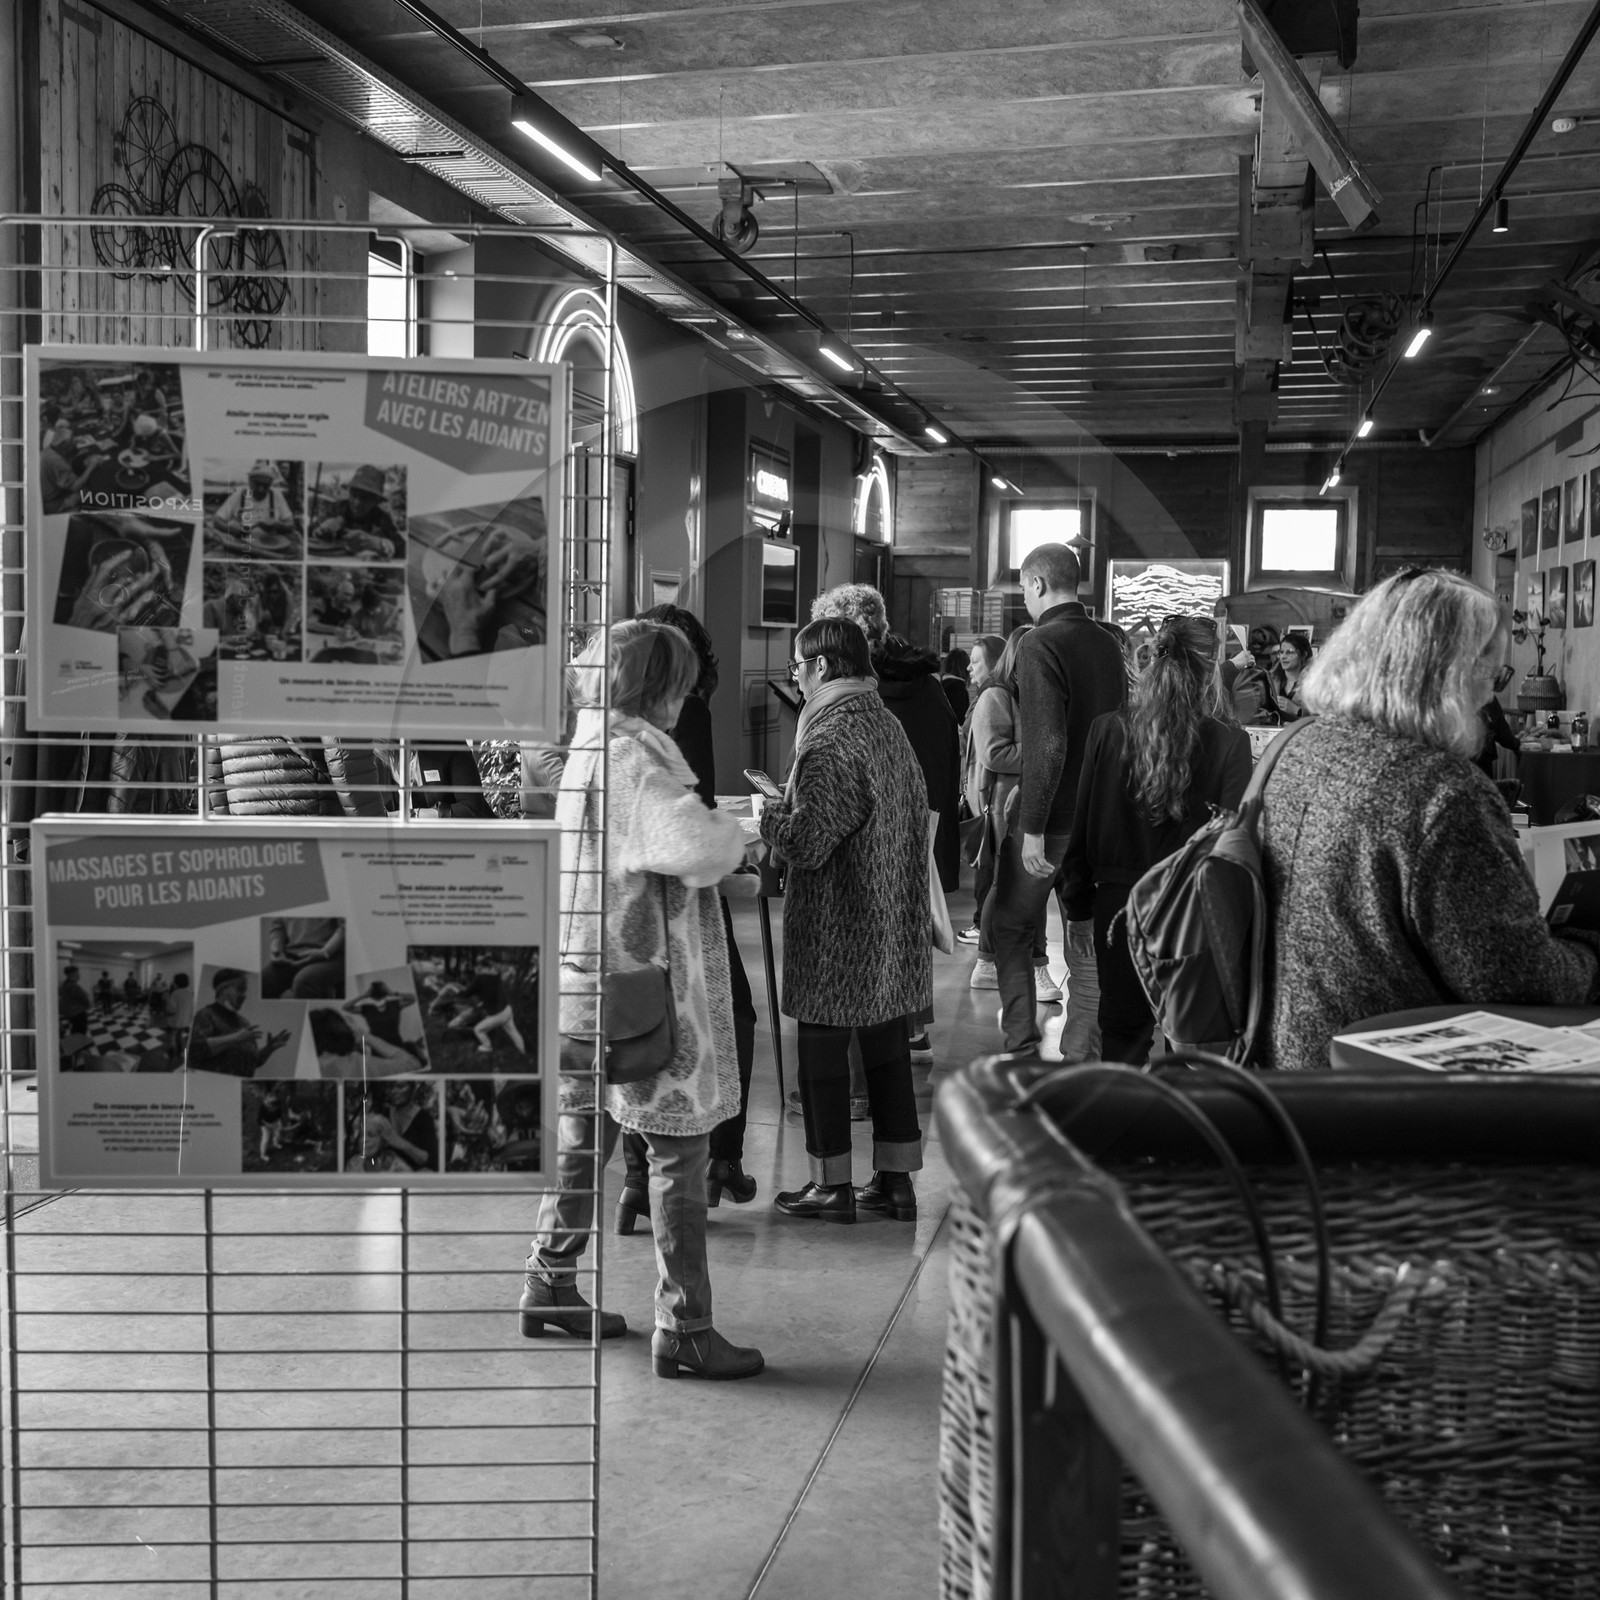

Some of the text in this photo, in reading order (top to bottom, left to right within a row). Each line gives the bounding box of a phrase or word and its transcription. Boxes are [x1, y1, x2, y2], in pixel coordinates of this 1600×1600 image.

[382, 372, 550, 426] ATELIERS ART'ZEN
[376, 399, 546, 456] AVEC LES AIDANTS
[48, 842, 305, 883] MASSAGES ET SOPHROLOGIE
[94, 874, 265, 909] POUR LES AIDANTS
